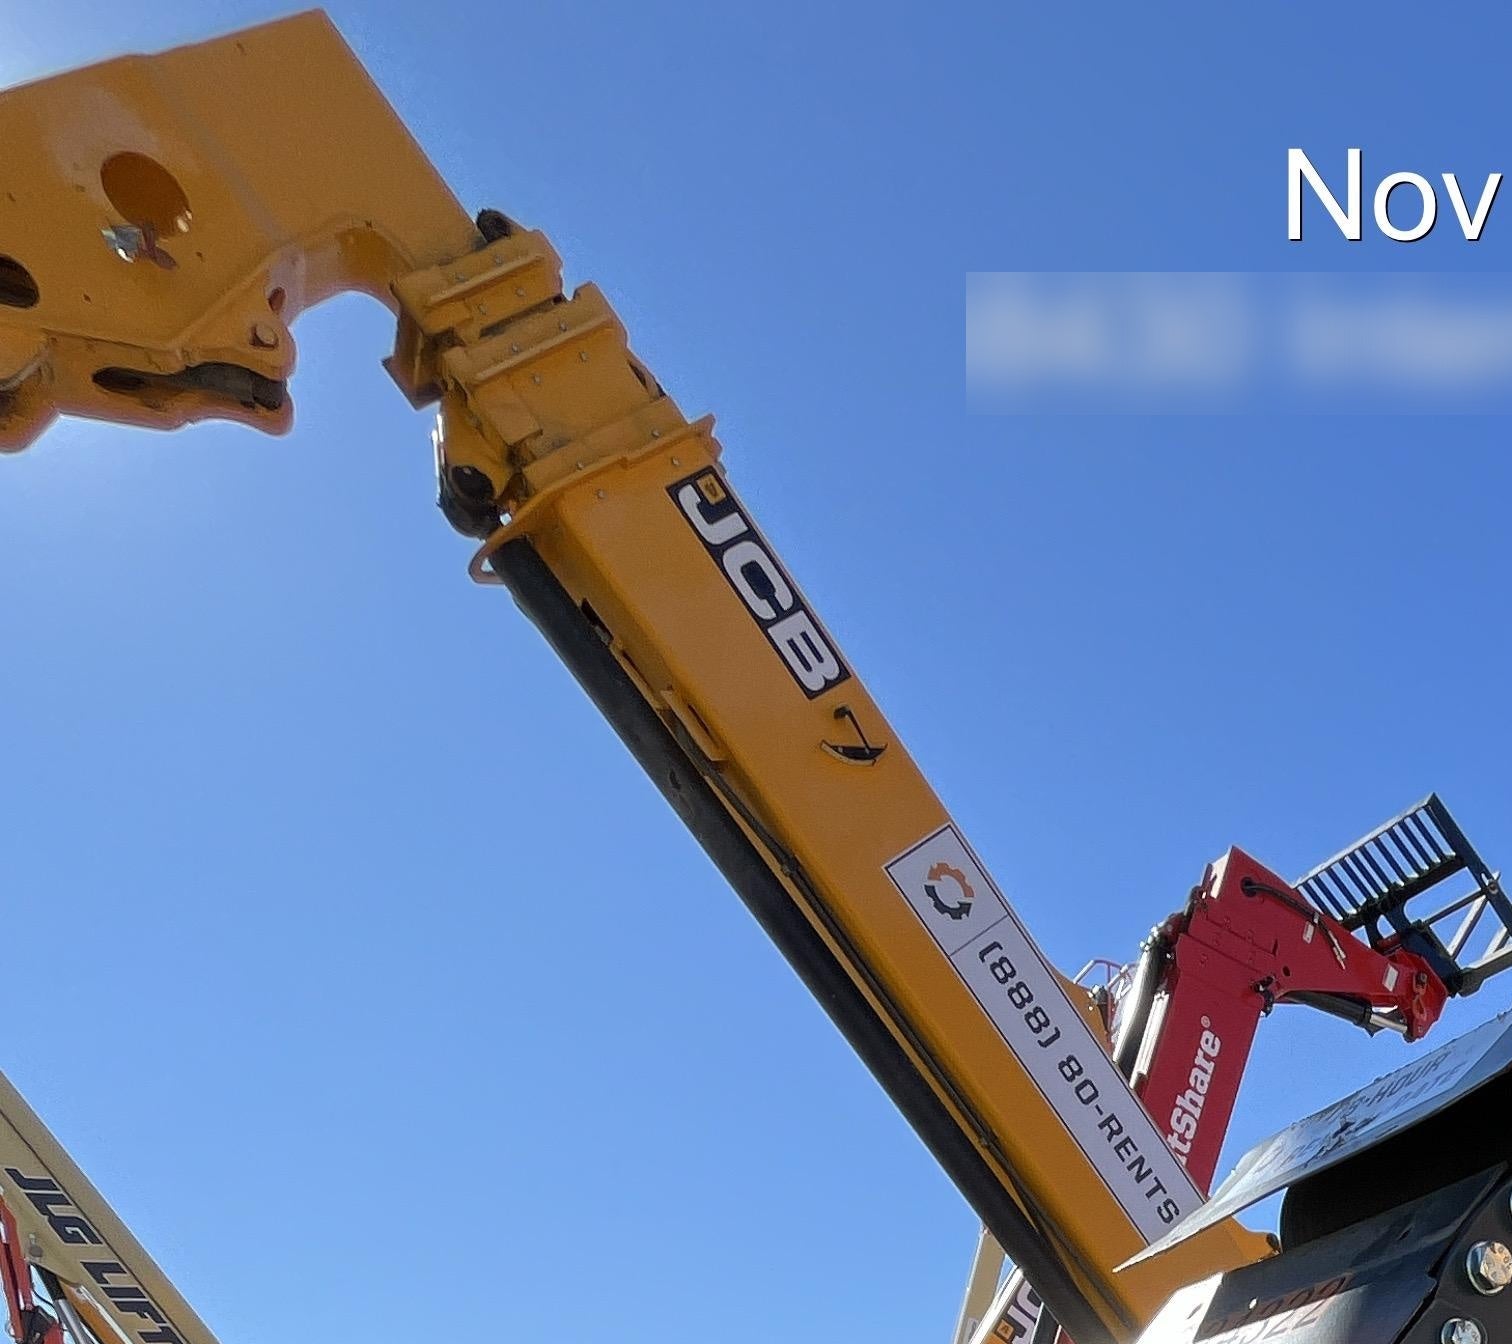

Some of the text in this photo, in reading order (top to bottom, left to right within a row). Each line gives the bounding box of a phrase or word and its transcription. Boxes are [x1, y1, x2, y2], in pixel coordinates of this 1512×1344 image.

[678, 484, 840, 692] JCB
[979, 941, 1180, 1225] (888) 80-RENTS
[4, 1167, 104, 1246] JLG
